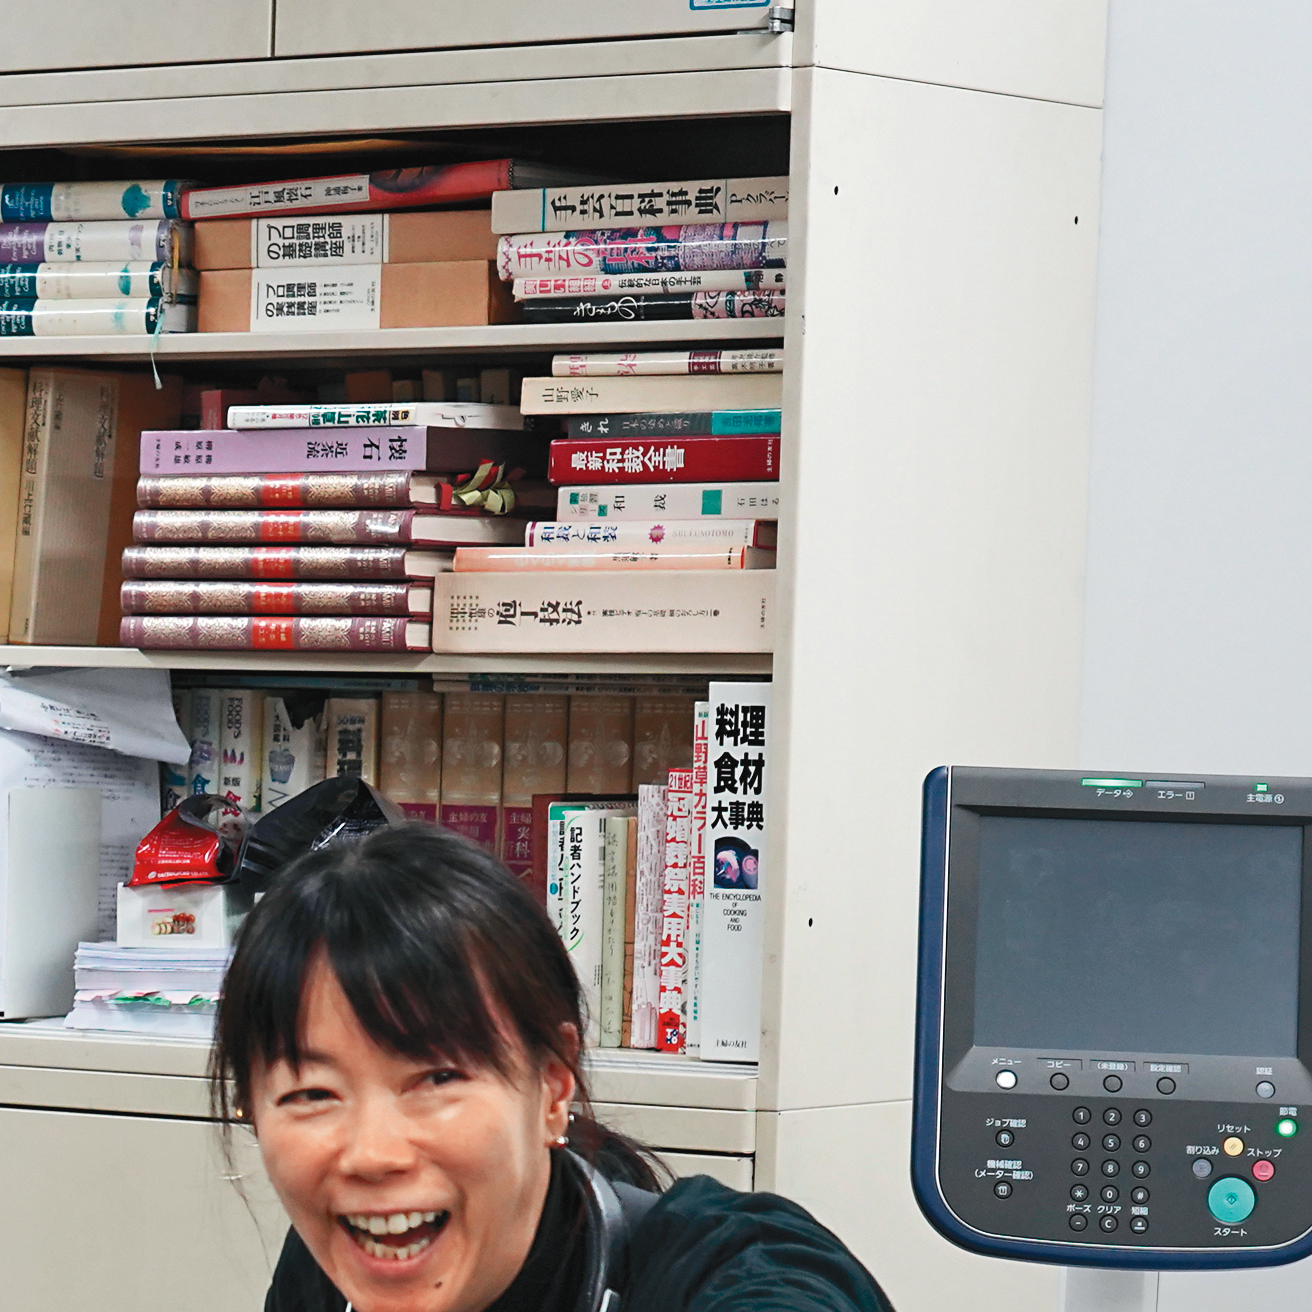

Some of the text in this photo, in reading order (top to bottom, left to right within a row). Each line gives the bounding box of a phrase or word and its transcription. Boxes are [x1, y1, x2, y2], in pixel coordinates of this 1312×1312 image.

[249, 187, 313, 206] 江戸風懐石
[550, 185, 721, 221] 手芸百科事典
[267, 222, 344, 240] プロ調理師
[267, 240, 344, 260] の基礎講座
[266, 282, 317, 298] プロ調理師
[265, 300, 317, 317] の実践講座
[573, 296, 637, 319] きもの
[542, 387, 599, 403] 山野愛子
[580, 417, 610, 434] きれ
[306, 436, 408, 462] 懐石 近茶流
[572, 445, 685, 473] 最新和裁全書
[540, 526, 619, 543] 和裁と和装
[715, 703, 766, 746] 料理
[713, 752, 765, 795] 食材
[223, 777, 241, 786] 新版
[1096, 789, 1121, 797] データ
[1157, 791, 1183, 799] エラー
[1246, 793, 1273, 802] 主電源
[690, 719, 708, 900] 山野草カラー百科
[711, 800, 764, 830] 大事典
[569, 826, 583, 941] 記者ハンドブック
[721, 893, 762, 902] ENCYCLOPEDIA
[723, 908, 747, 917] COOKING
[716, 1039, 747, 1049] 主婦の友社
[991, 1058, 1021, 1066] メニュー
[1150, 1064, 1182, 1073] 設定確認
[1256, 1067, 1273, 1075] 認証
[1279, 1107, 1297, 1116] 節電
[1109, 1113, 1115, 1121] 2
[1140, 1114, 1146, 1122] 3
[985, 1118, 1027, 1128] ジョブ確認
[1217, 1124, 1251, 1133] リセット
[1078, 1138, 1084, 1146] 4
[1108, 1139, 1114, 1147] 5
[1139, 1140, 1145, 1148] 6
[1186, 1146, 1220, 1155] 割り込み
[1247, 1148, 1282, 1158] ストップ
[987, 1160, 1022, 1169] 機械確認
[1077, 1163, 1083, 1172] 7
[1108, 1165, 1114, 1173] 8
[1138, 1166, 1144, 1174] 9
[1107, 1190, 1113, 1199] 0
[1066, 1204, 1092, 1213] ポーズ
[1097, 1205, 1121, 1214] クリア
[1105, 1220, 1112, 1229] C
[1214, 1227, 1248, 1237] スタート
